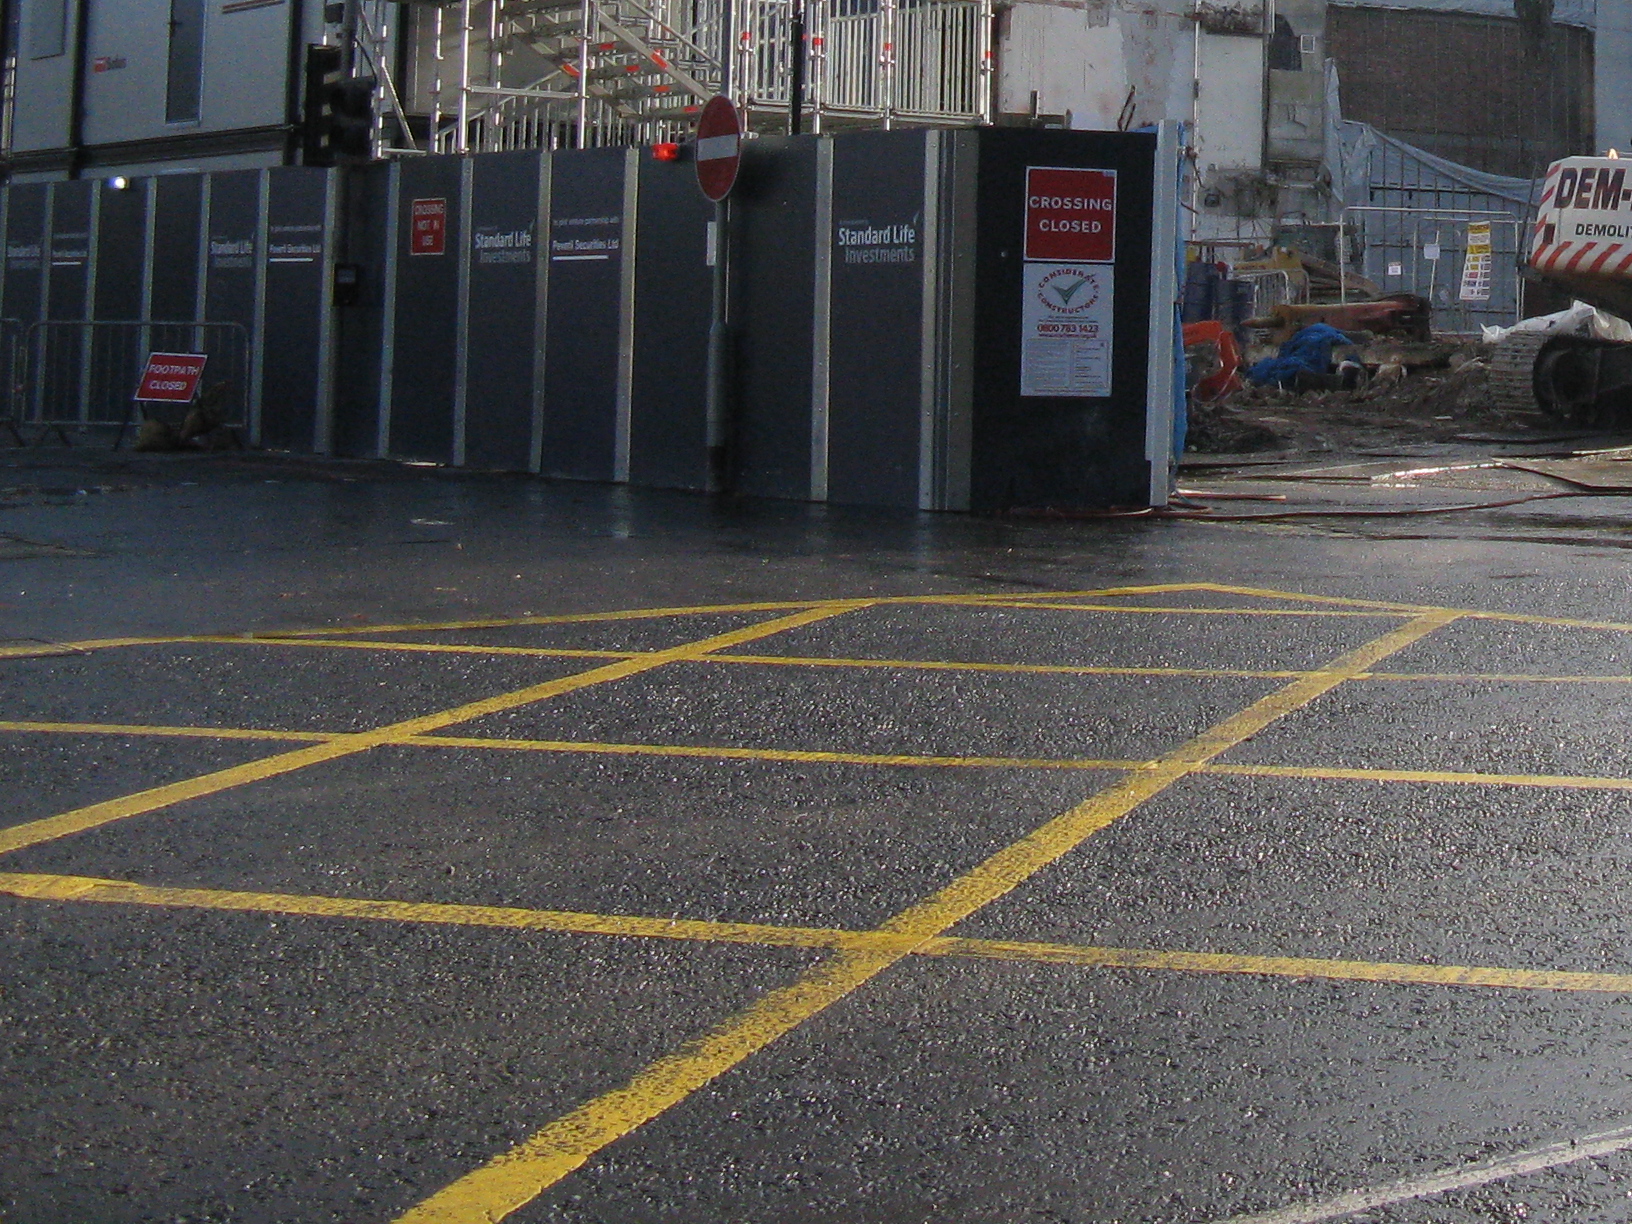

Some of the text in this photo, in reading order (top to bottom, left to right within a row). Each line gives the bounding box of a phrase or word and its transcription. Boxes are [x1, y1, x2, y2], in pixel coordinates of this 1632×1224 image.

[1029, 196, 1112, 211] CROSSING
[1040, 219, 1101, 233] CLOSED
[475, 230, 531, 249] Standard Life
[838, 224, 915, 245] Standard Life
[845, 246, 915, 263] Investments
[1037, 292, 1099, 314] CONSTRUCTORS
[149, 364, 199, 375] FOOTPATH
[149, 380, 188, 391] CLOSED
